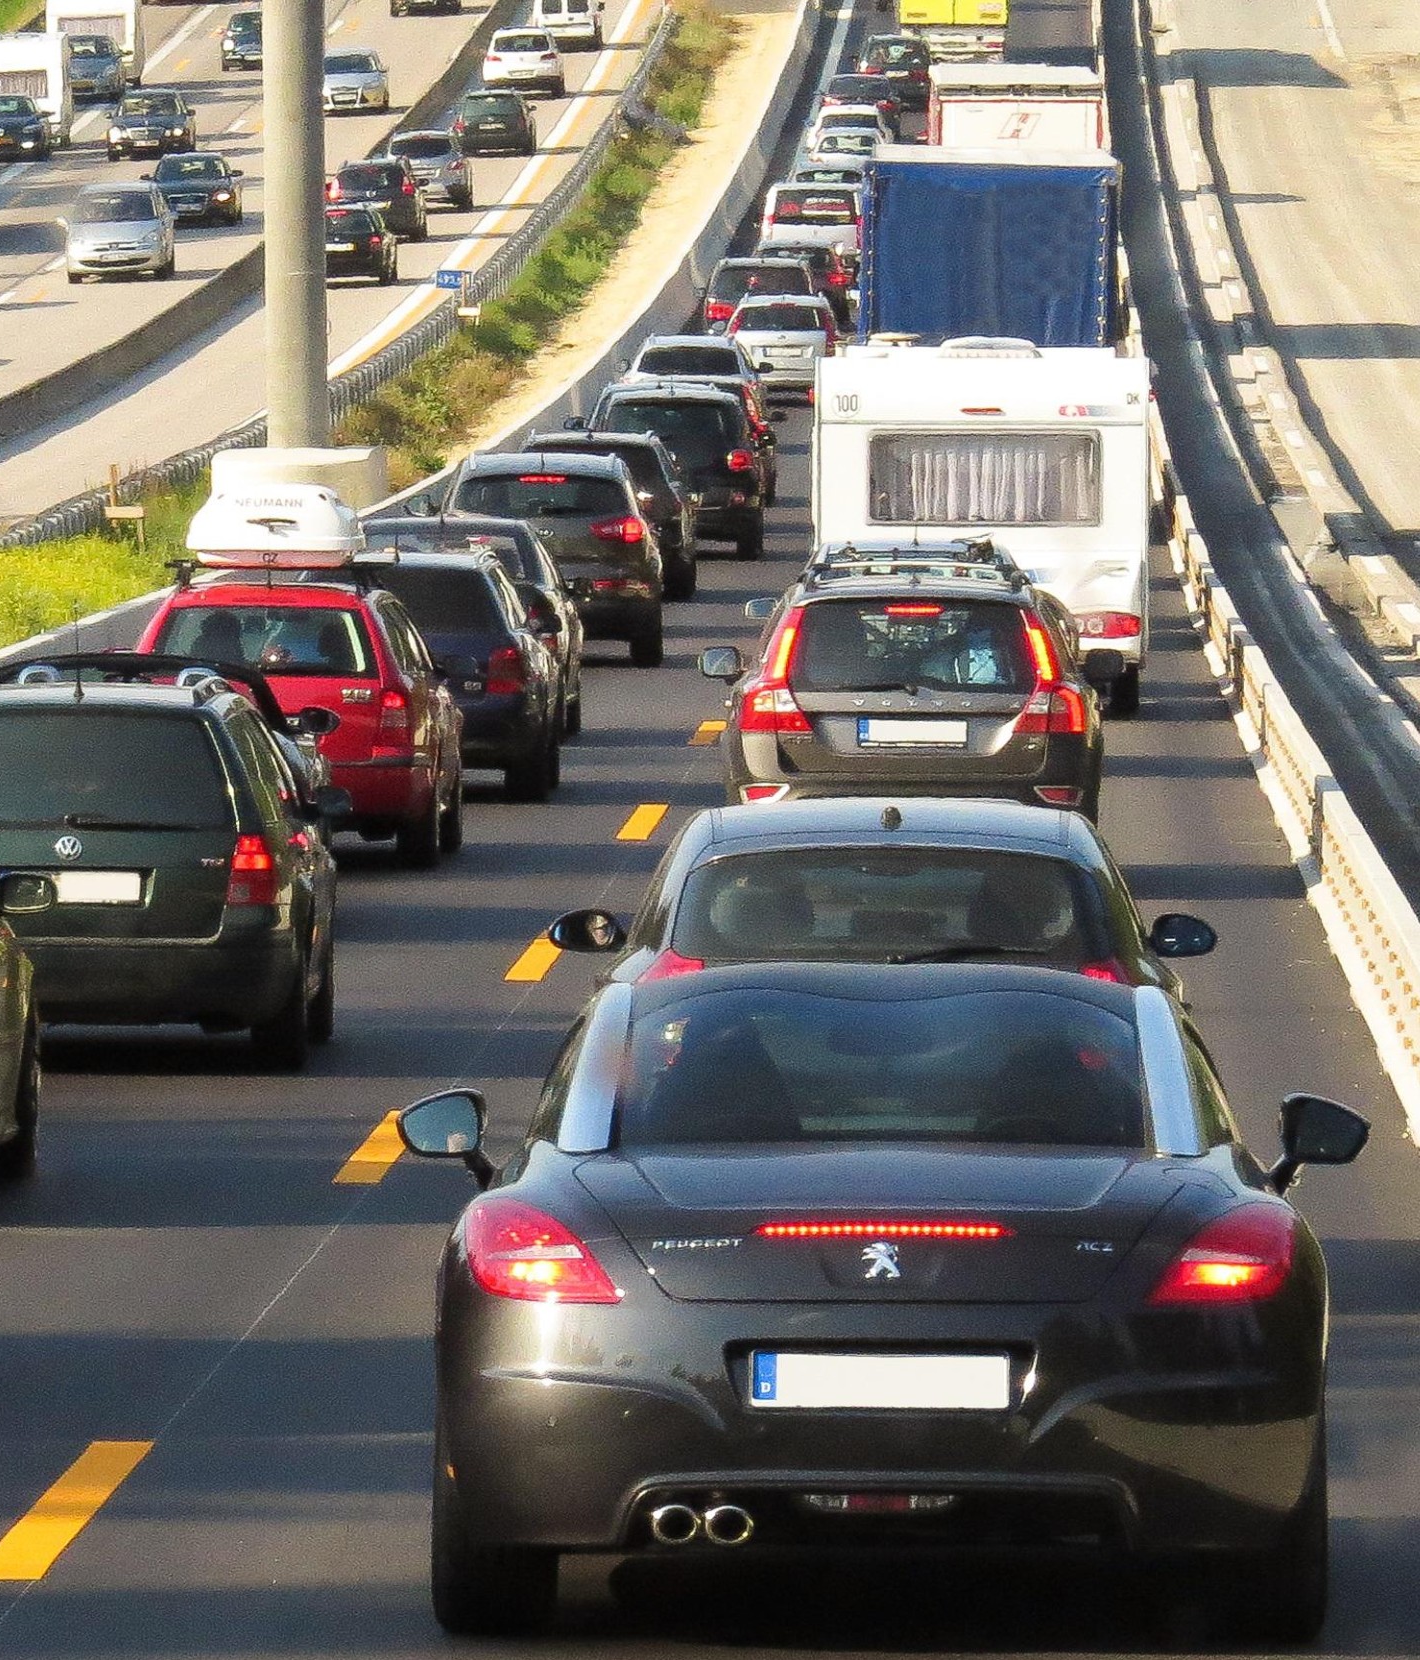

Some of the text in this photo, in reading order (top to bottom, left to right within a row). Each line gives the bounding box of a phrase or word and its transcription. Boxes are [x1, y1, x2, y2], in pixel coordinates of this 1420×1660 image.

[835, 394, 859, 413] 100
[1126, 393, 1140, 405] DK
[235, 498, 303, 508] NEUMANN
[652, 1238, 743, 1250] PEUGEOT
[760, 1381, 771, 1394] D
